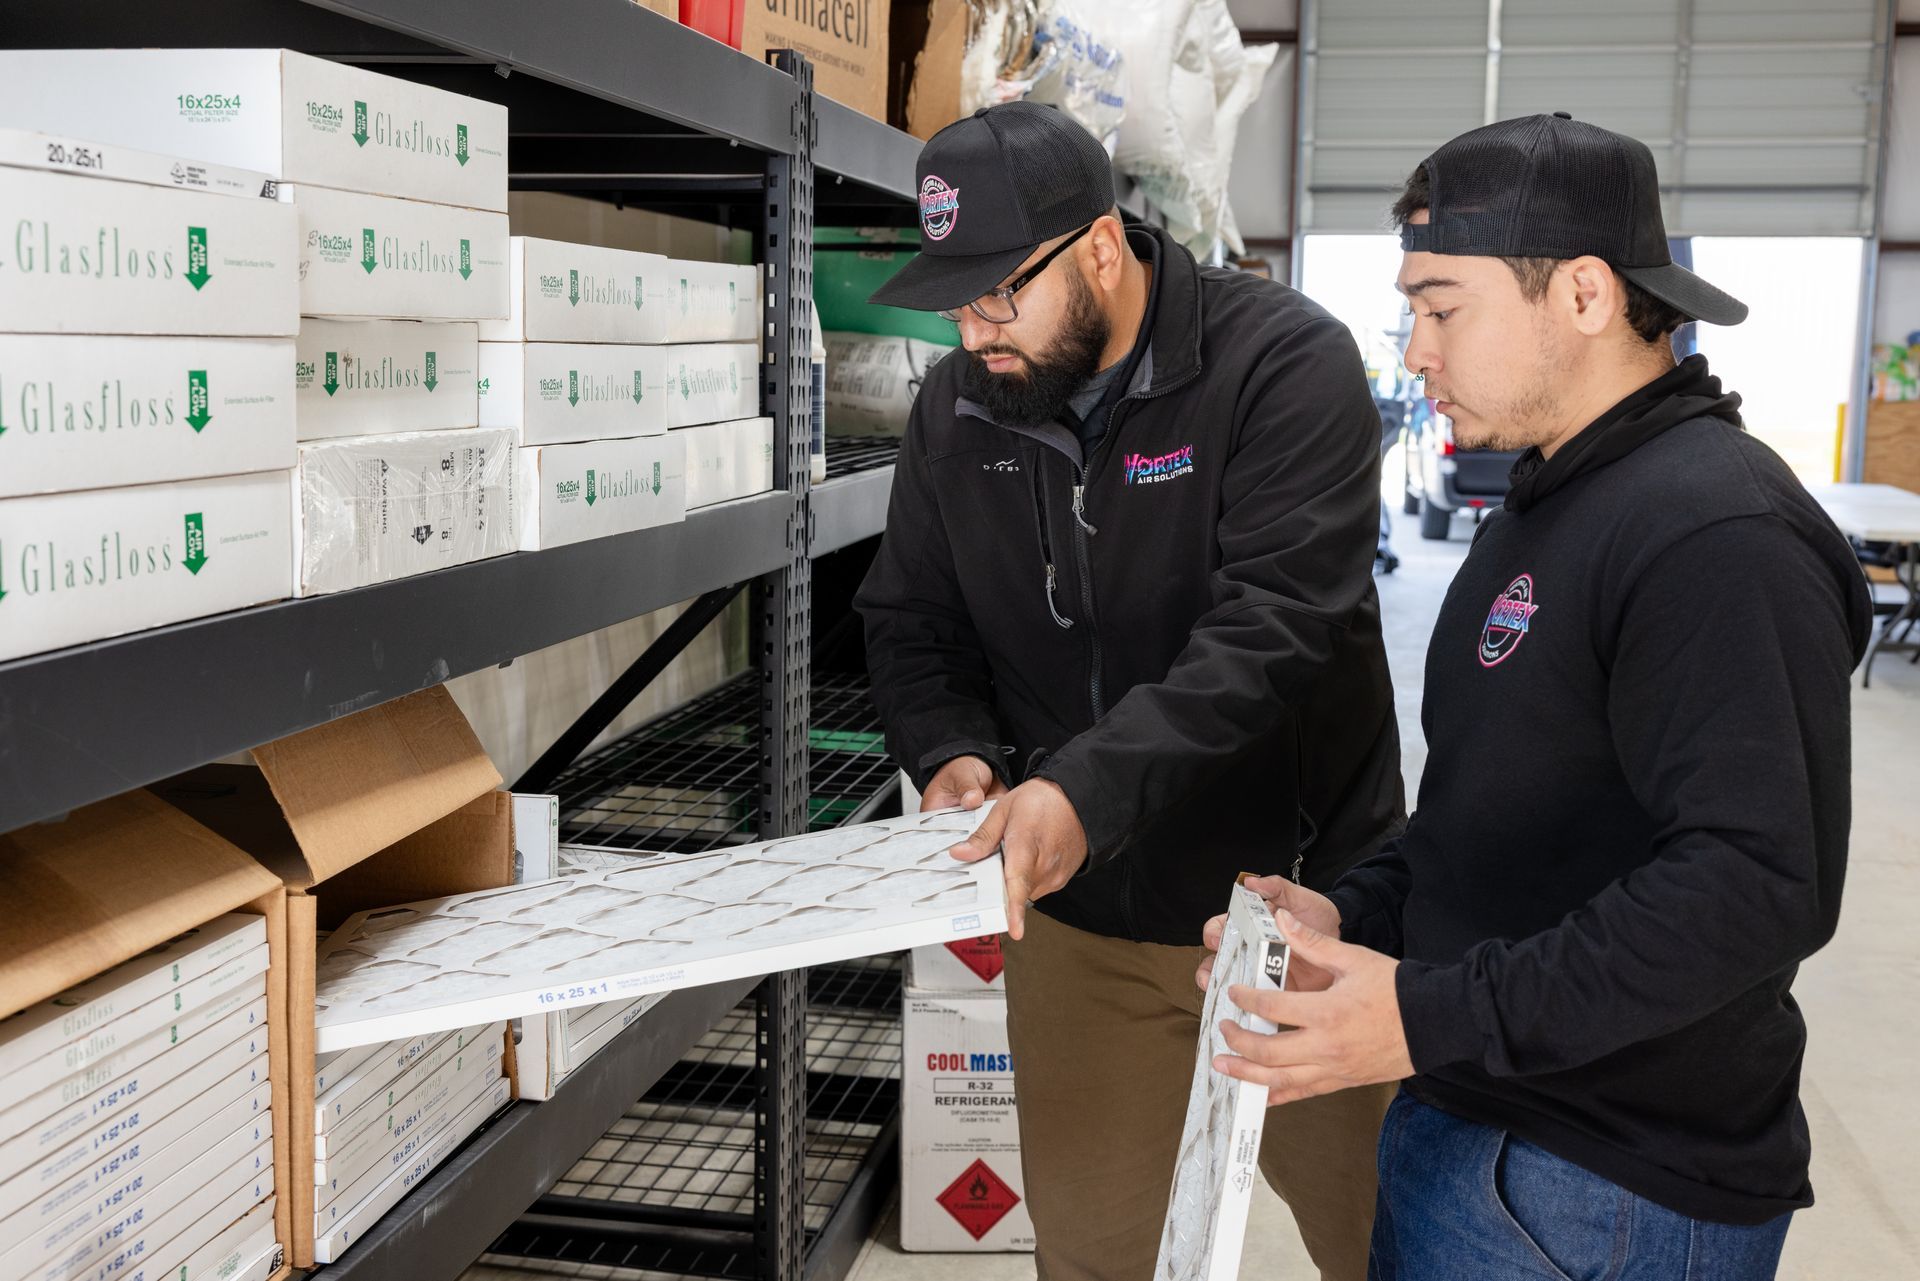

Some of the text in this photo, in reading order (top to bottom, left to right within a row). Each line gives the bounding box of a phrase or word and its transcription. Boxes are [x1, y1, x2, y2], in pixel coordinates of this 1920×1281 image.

[178, 94, 240, 108] 16x25x4
[306, 102, 343, 121] 16x25x4
[376, 111, 450, 157] Glasfloss
[48, 144, 66, 163] 20
[75, 148, 90, 167] 25
[97, 152, 102, 169] 1
[919, 188, 959, 218] VORTEX
[16, 219, 173, 280] Glasfloss
[318, 235, 352, 250] 16x25x4
[191, 235, 199, 274] FLOW
[383, 236, 454, 273] Glasfloss
[540, 275, 563, 288] 16x25x4
[584, 275, 632, 304] Glasfloss
[344, 357, 419, 390] Glasfloss
[540, 379, 562, 390] 16x25x4
[583, 374, 630, 401] Glasfloss
[21, 380, 174, 434] Glasfloss
[442, 459, 450, 470] 8
[1124, 446, 1192, 484] VORTEX
[1154, 466, 1193, 482] SOLUTIONS
[556, 480, 580, 494] 16x25x4
[600, 469, 649, 500] Glasfloss
[442, 530, 448, 540] 8
[22, 532, 171, 595] Glasfloss
[1484, 594, 1539, 632] VORTEX
[1267, 956, 1283, 968] 5
[538, 992, 554, 1004] 16
[568, 987, 584, 998] 25
[601, 983, 608, 992] 1
[409, 1046, 416, 1058] 25
[928, 1053, 1014, 1072] COOLMAST
[128, 1080, 137, 1094] 20
[968, 1082, 993, 1090] R-32
[108, 1091, 118, 1106] 25
[935, 1096, 1016, 1106] REFRIGERAN
[129, 1112, 139, 1128] 20
[394, 1126, 400, 1138] 16
[406, 1116, 413, 1129] 25
[109, 1125, 119, 1140] 25
[129, 1145, 139, 1160] 20
[393, 1153, 399, 1165] 16
[404, 1143, 412, 1154] 25
[110, 1157, 120, 1173] 25
[133, 1176, 143, 1191] 20
[404, 1176, 410, 1187] 16
[415, 1166, 422, 1177] 25
[113, 1189, 123, 1205] 25
[133, 1209, 143, 1224] 20
[113, 1222, 123, 1238] 25
[134, 1240, 144, 1255] 20
[115, 1254, 125, 1270] 25
